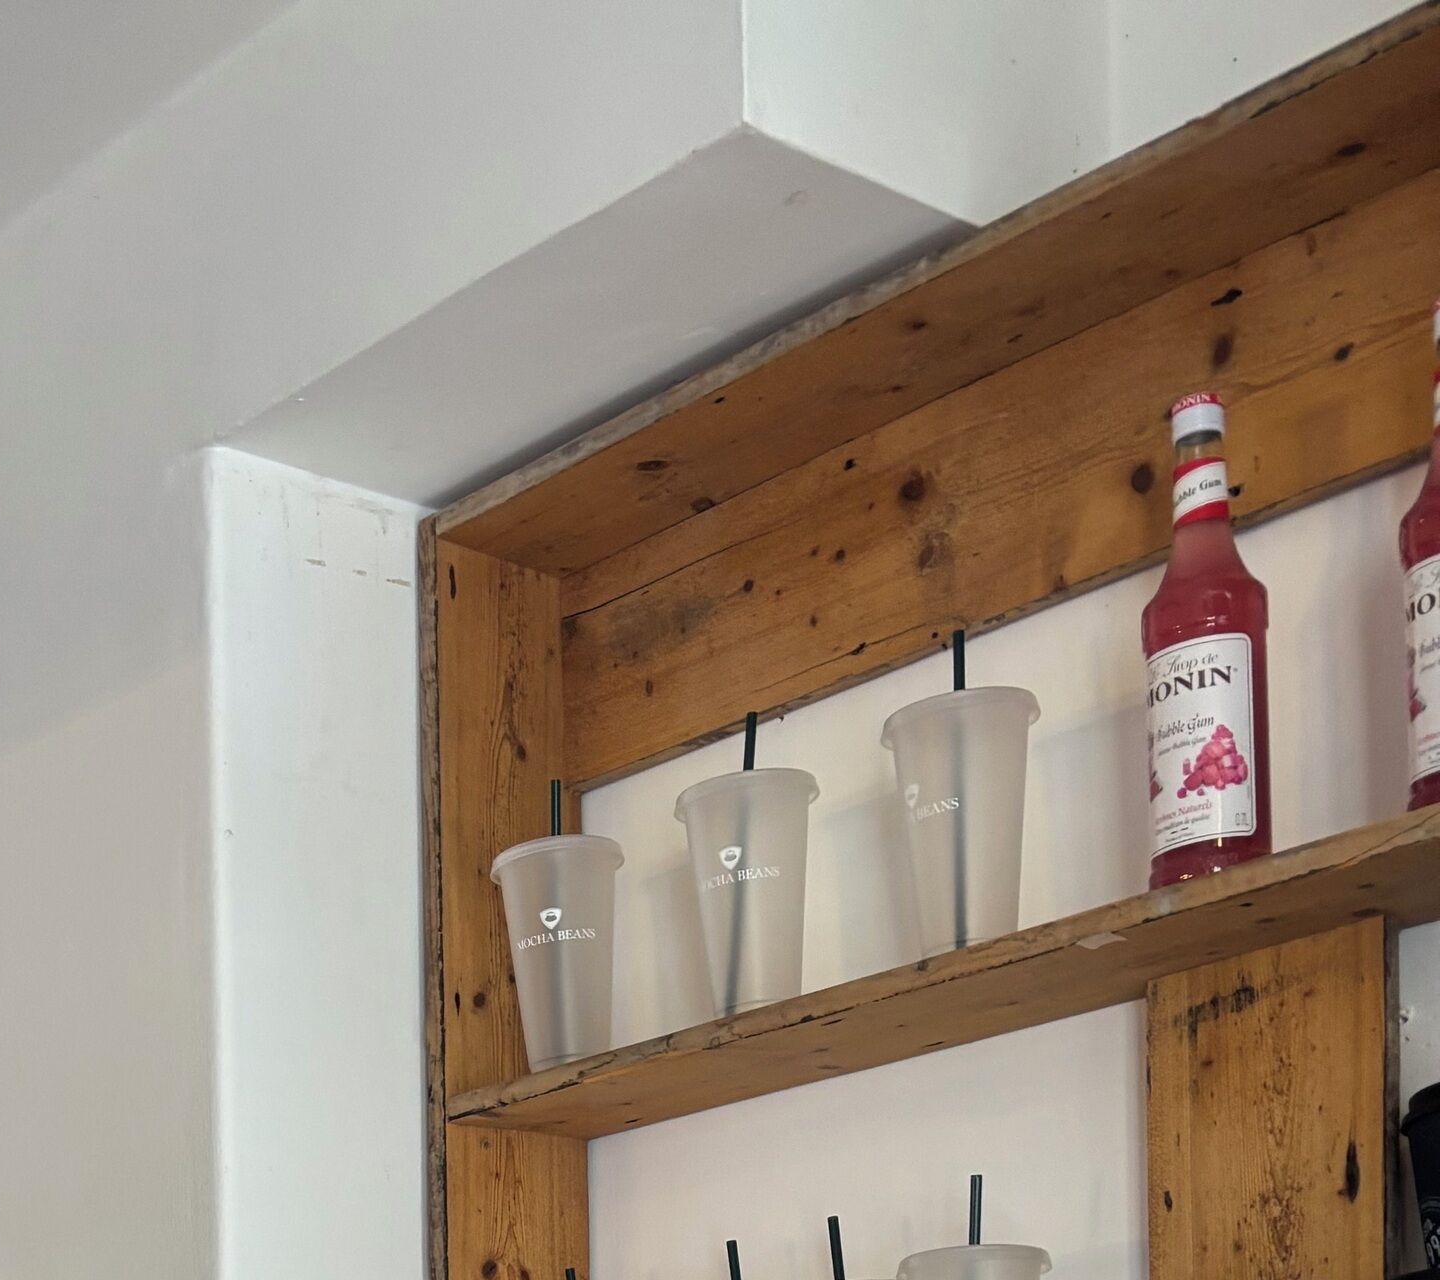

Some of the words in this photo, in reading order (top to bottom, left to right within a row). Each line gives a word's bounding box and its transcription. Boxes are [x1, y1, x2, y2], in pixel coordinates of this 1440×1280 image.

[1172, 393, 1211, 412] ONIN
[737, 867, 780, 880] BEANS
[517, 932, 555, 950] MOCHA
[558, 928, 596, 941] BEANS
